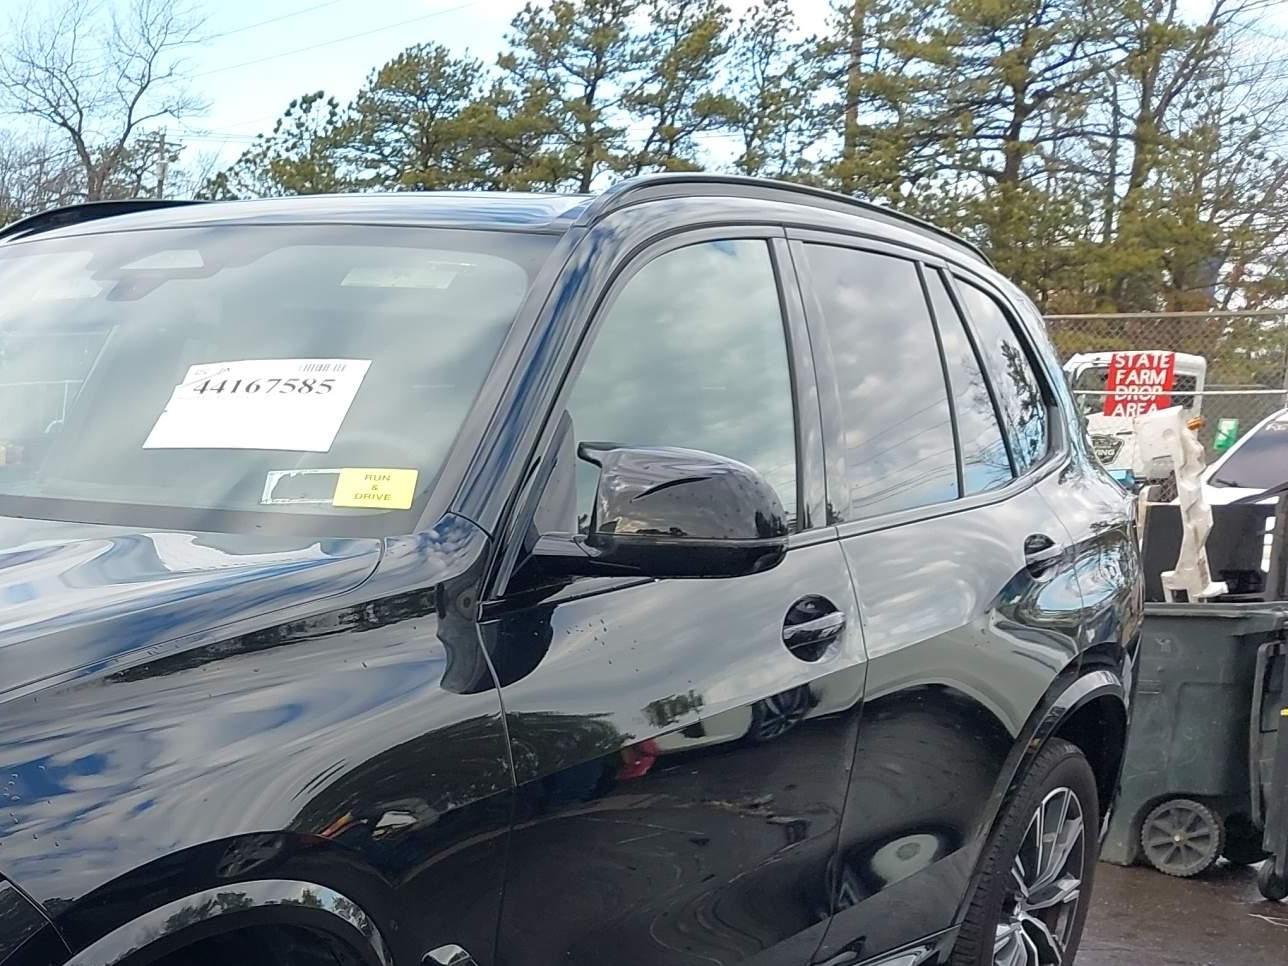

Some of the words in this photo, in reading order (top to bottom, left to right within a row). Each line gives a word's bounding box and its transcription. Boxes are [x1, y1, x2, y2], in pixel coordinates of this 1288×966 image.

[1114, 353, 1171, 369] STATE
[1114, 369, 1167, 385] FARM
[193, 378, 336, 395] 44167585
[1114, 385, 1163, 401] DROP
[1112, 402, 1158, 417] AREA
[364, 474, 392, 482] RUN
[353, 493, 392, 501] DRIVE
